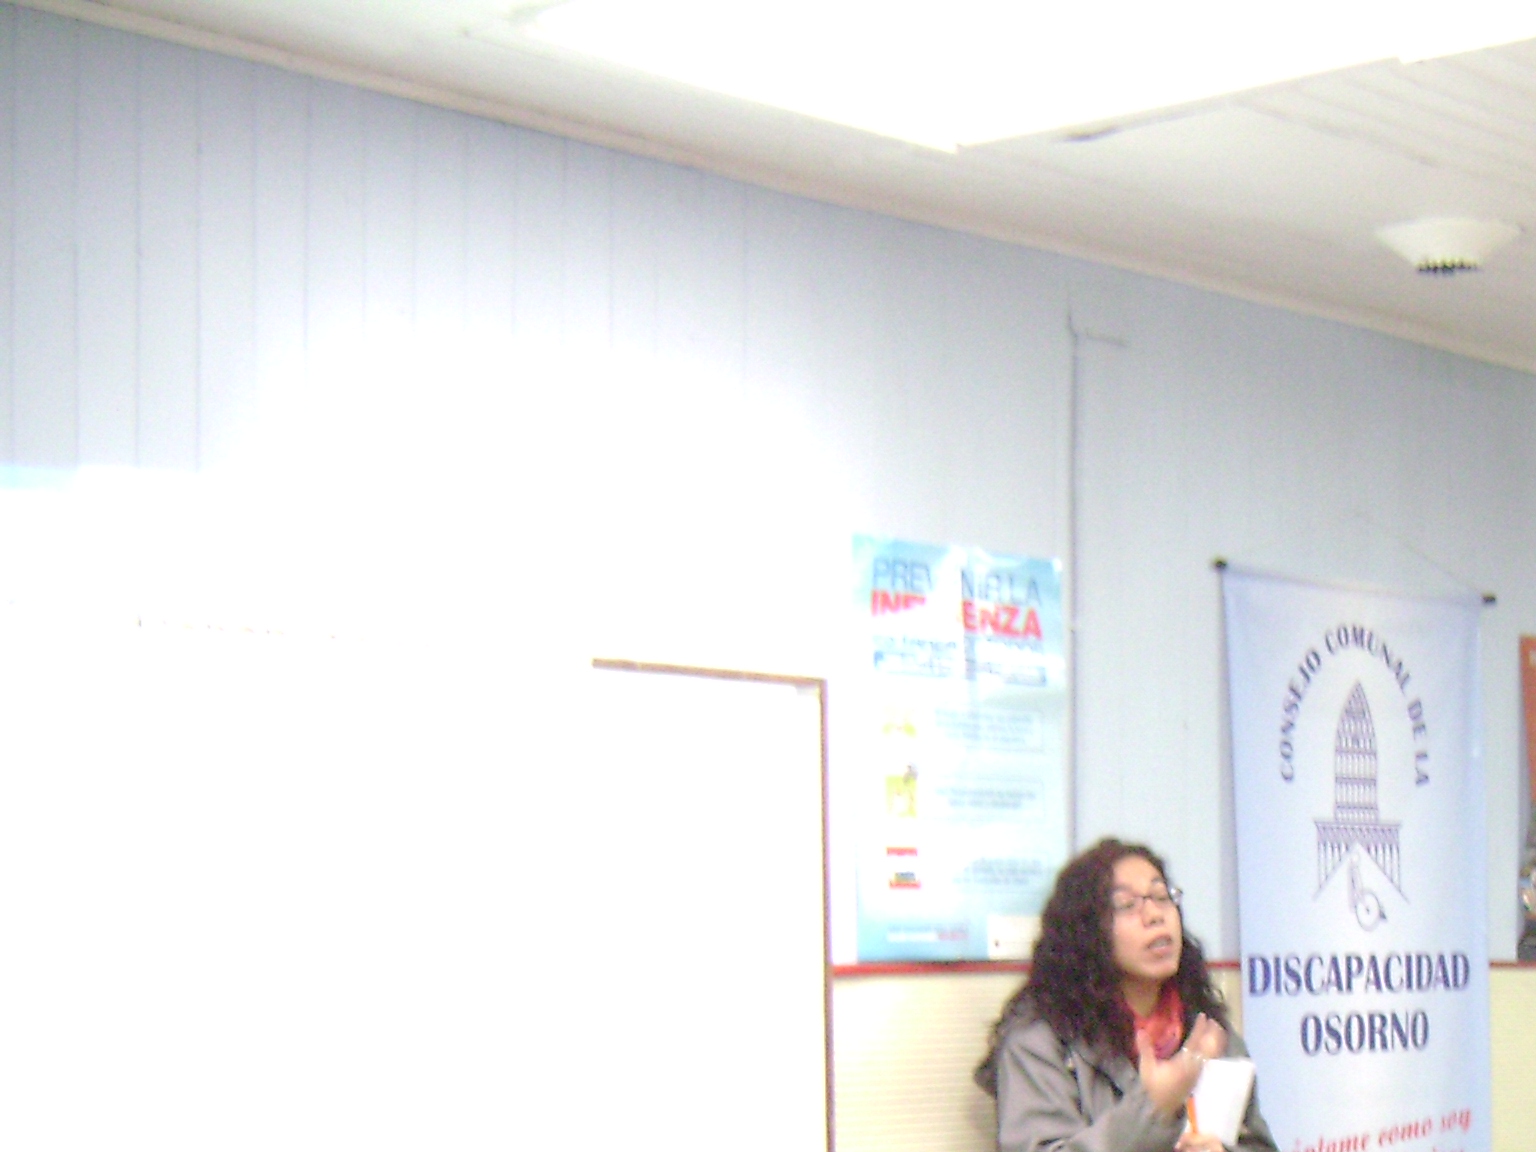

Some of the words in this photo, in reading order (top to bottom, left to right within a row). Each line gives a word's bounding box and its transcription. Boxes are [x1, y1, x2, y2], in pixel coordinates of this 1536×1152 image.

[1325, 622, 1411, 697] COMUNAL
[1279, 648, 1321, 783] CONSEJO
[1407, 697, 1426, 741] DE
[1415, 749, 1430, 788] LA
[1249, 951, 1471, 998] DISCAPACIDAD
[1300, 1008, 1429, 1057] OSORNO
[1377, 1117, 1433, 1148] como
[1440, 1108, 1472, 1132] soy
